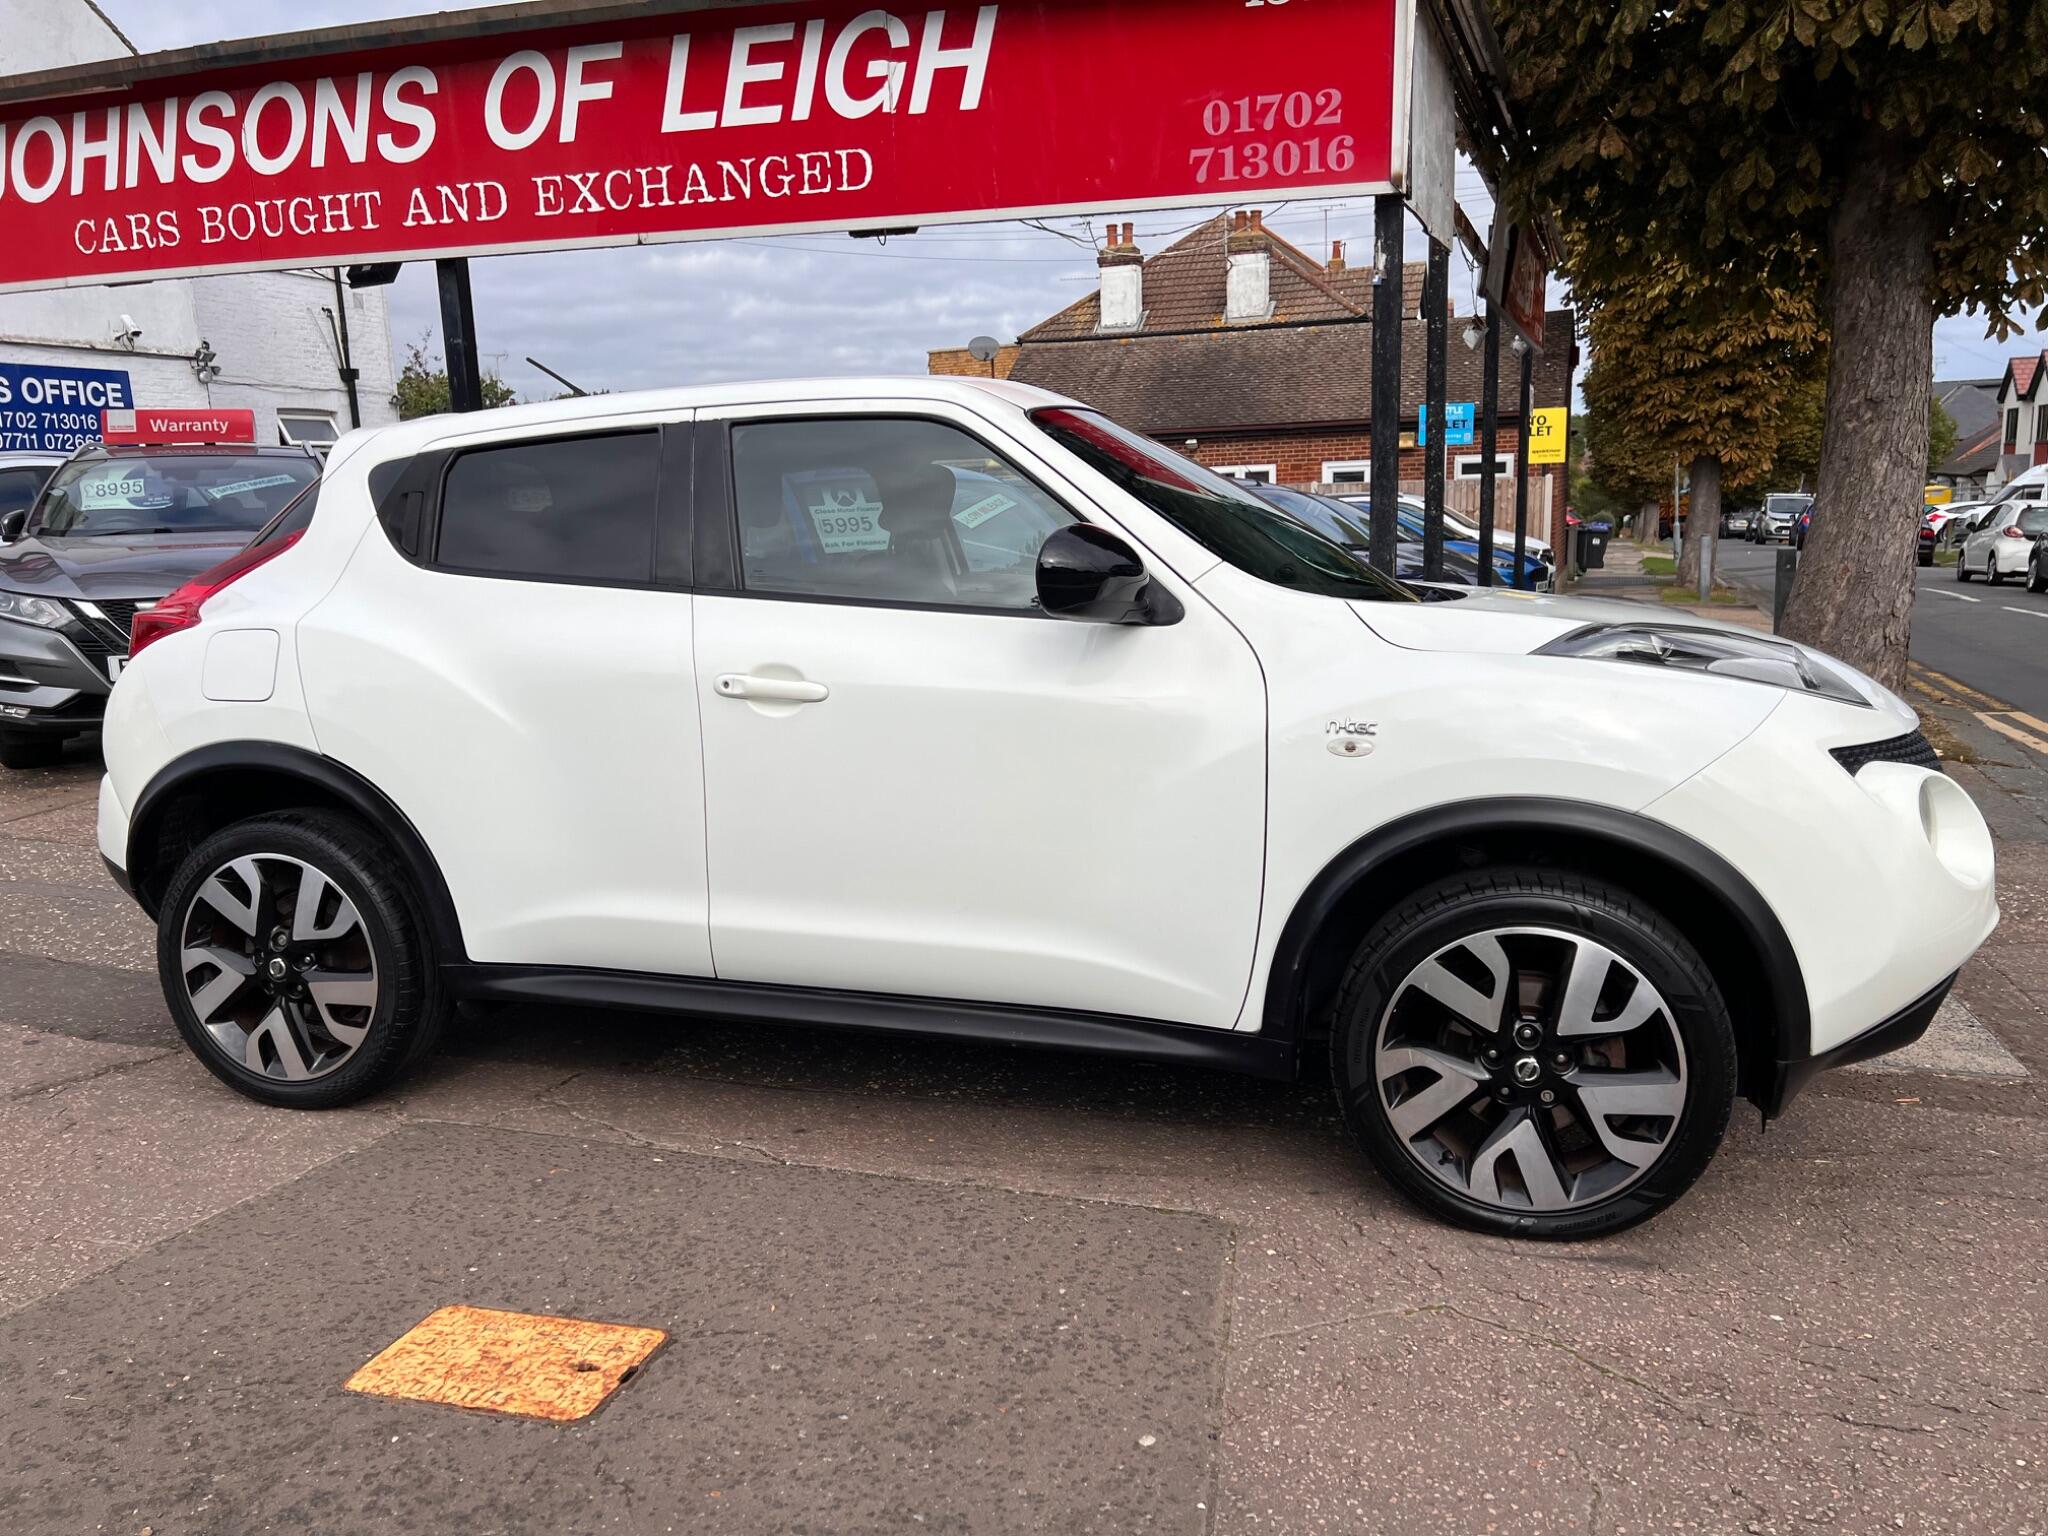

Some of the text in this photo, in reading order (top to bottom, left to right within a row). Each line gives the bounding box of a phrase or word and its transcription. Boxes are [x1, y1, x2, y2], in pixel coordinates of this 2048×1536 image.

[485, 41, 622, 150] OF
[661, 5, 998, 132] LEIGH
[1202, 88, 1343, 138] 01702
[1189, 135, 1355, 184] 713016
[74, 149, 873, 255] CARS BOUGHT AND EXCHANGED
[21, 377, 125, 408] OFFICE
[0, 411, 37, 429] 702
[41, 412, 98, 430] 713016
[150, 418, 229, 434] Warranty
[1529, 425, 1552, 437] LET
[0, 432, 103, 449] 7711 0726
[822, 516, 873, 534] 5995
